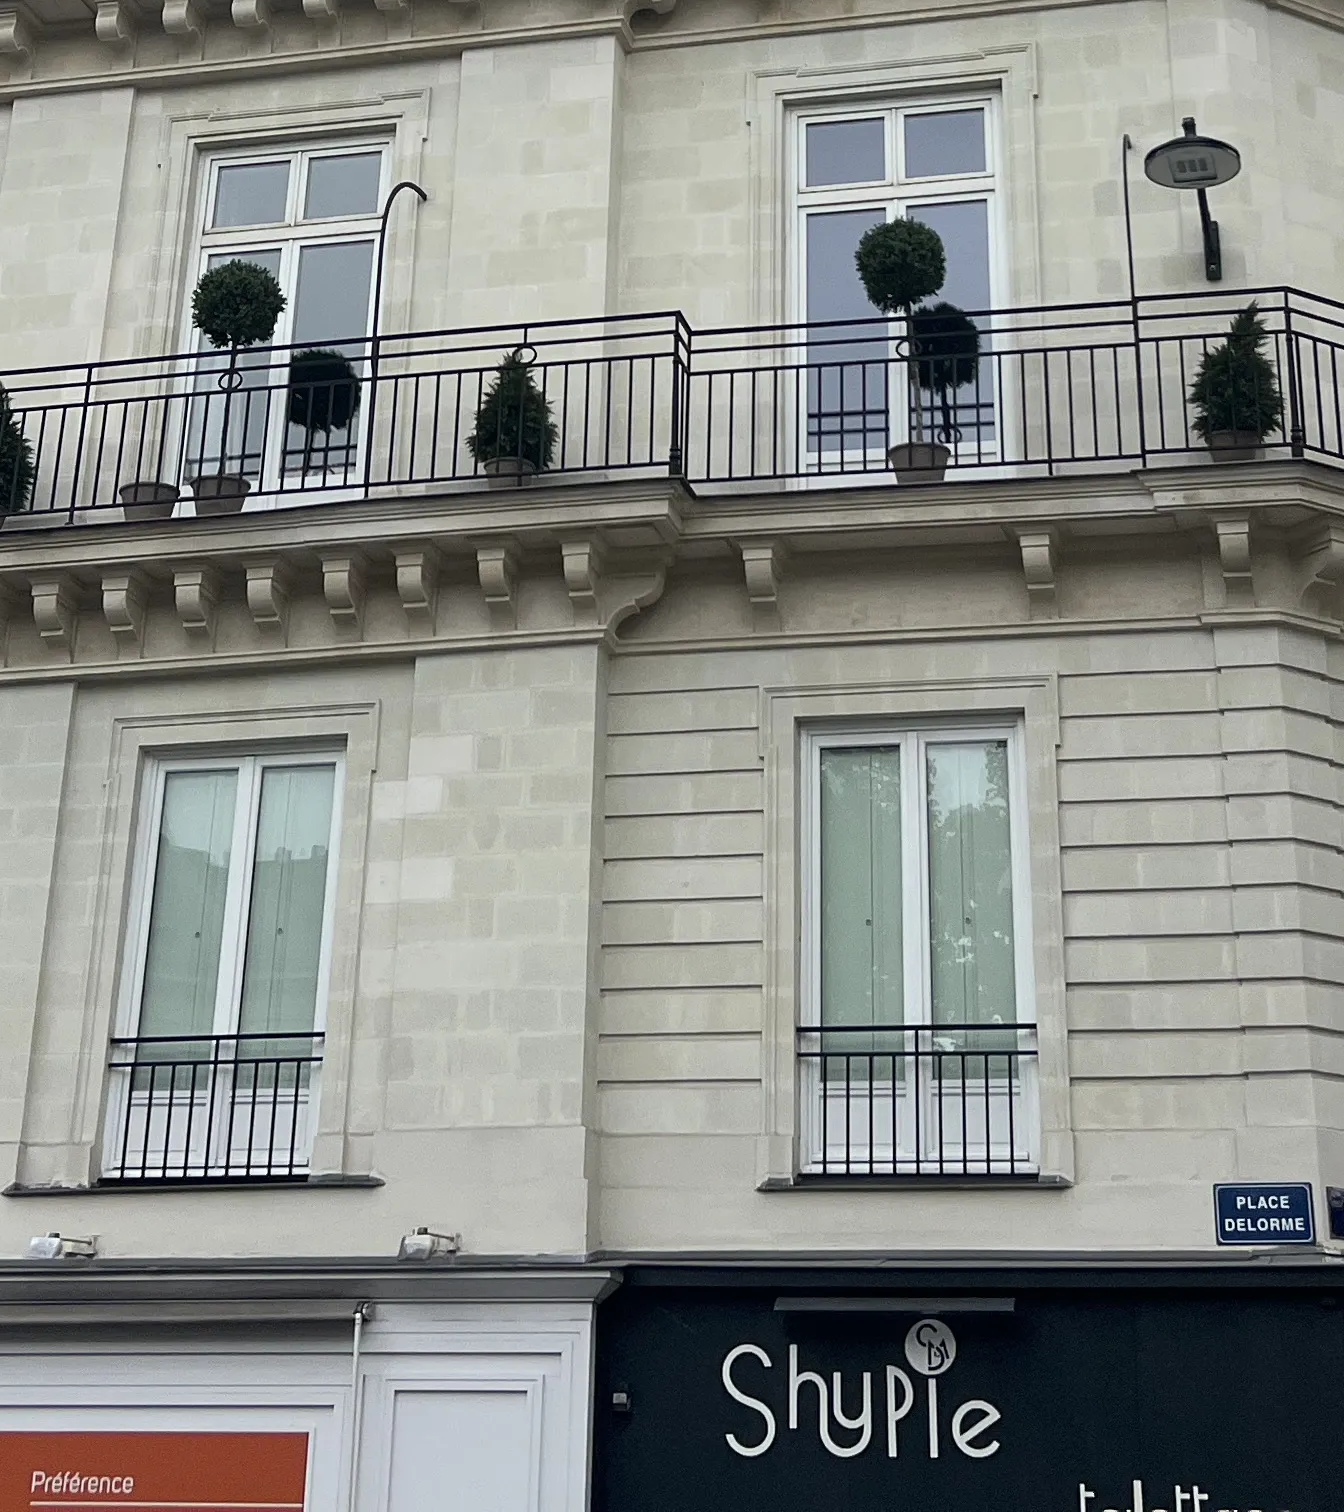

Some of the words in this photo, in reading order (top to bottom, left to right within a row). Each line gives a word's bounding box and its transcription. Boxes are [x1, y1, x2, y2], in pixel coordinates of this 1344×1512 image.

[1236, 1195, 1290, 1209] PLACE
[1224, 1217, 1305, 1231] DELORME
[30, 1470, 134, 1494] Préférence
